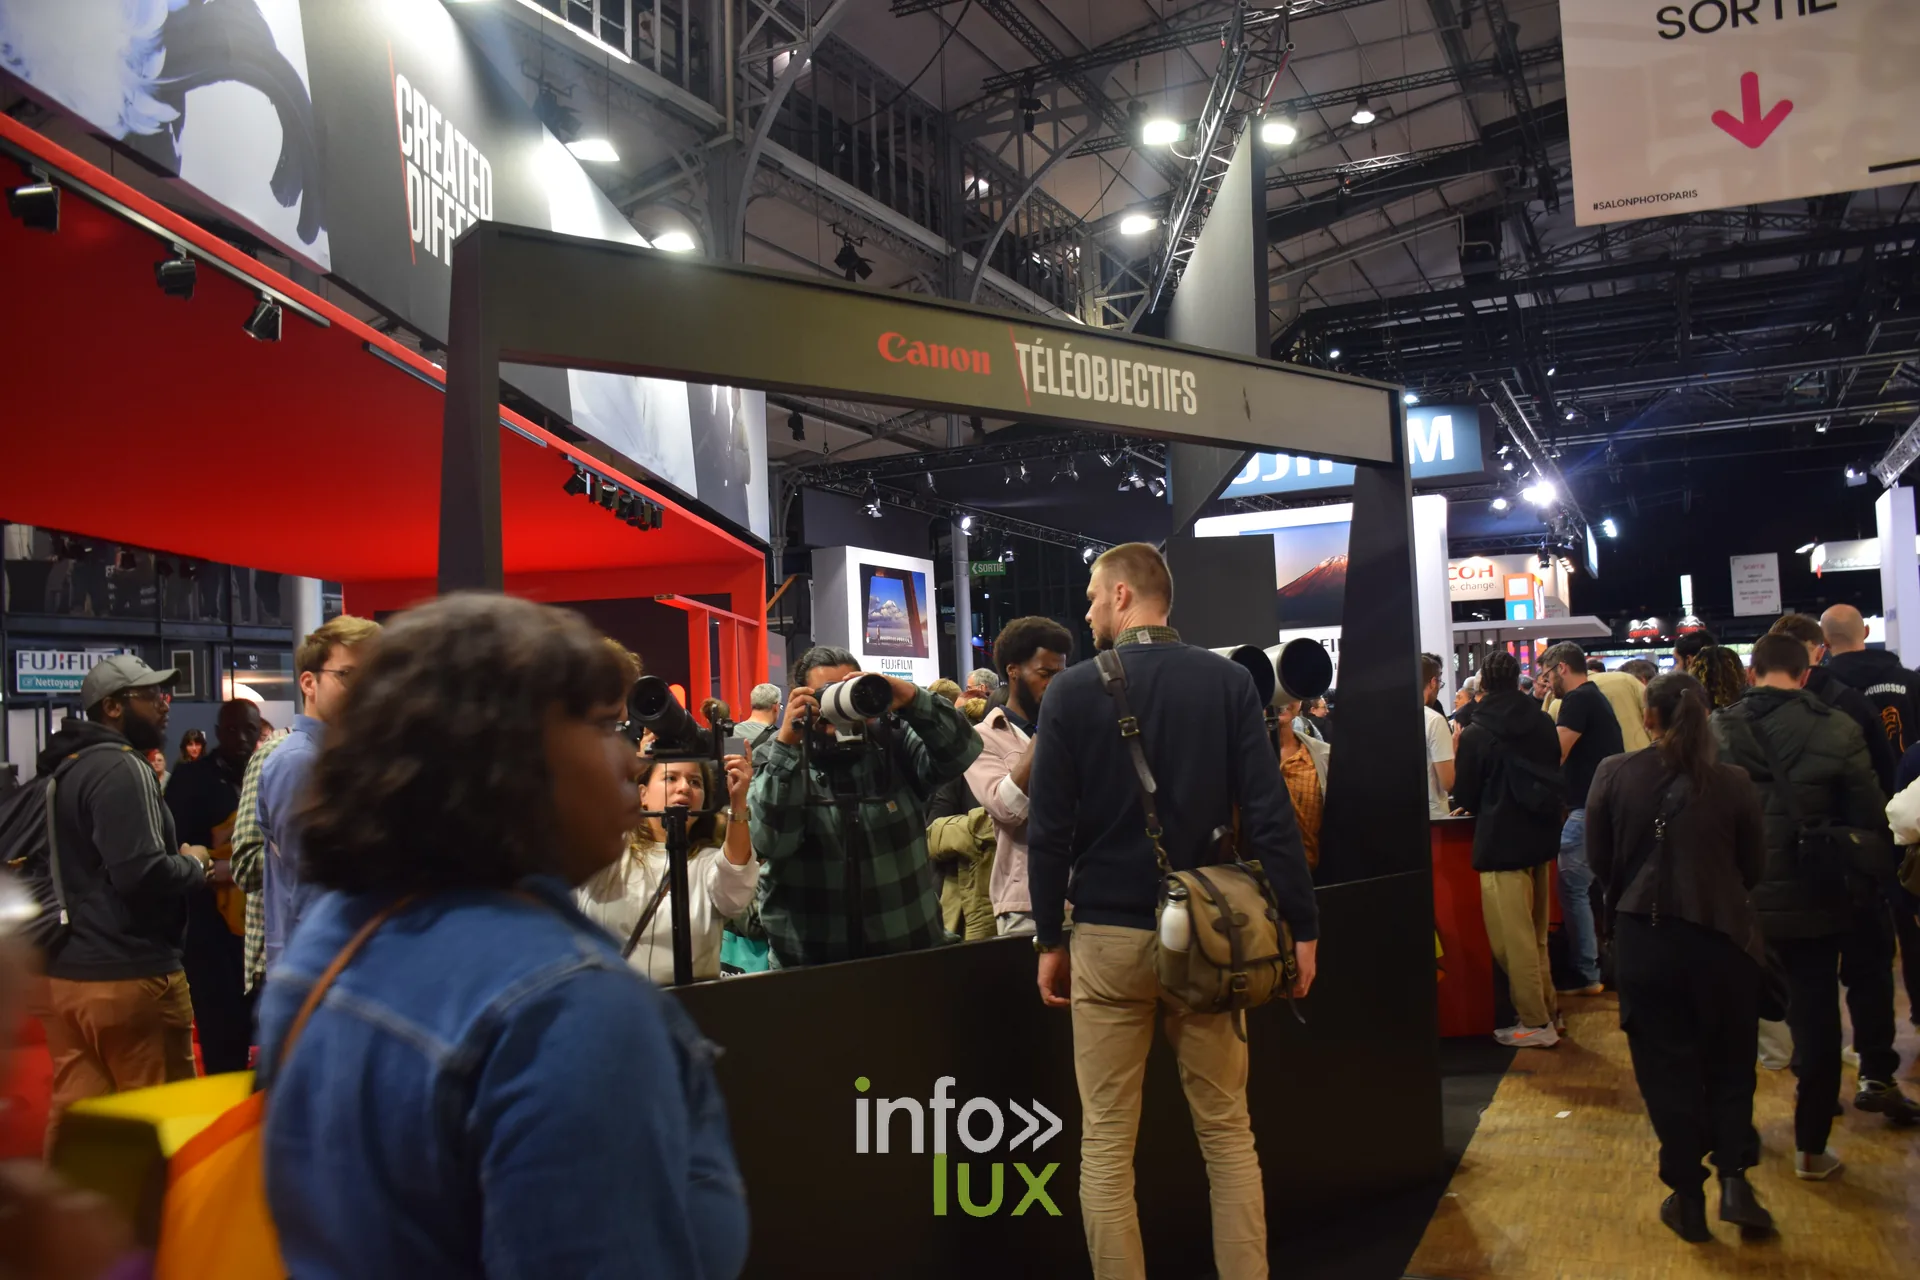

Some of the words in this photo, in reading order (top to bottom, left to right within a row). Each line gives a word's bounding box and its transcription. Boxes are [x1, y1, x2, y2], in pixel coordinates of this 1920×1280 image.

[396, 73, 493, 222] CREATED
[1593, 189, 1698, 211] #SALONPHOTOPARIS
[877, 331, 991, 375] Canon
[1015, 338, 1198, 415] TÉLÉOBJECTIFS
[977, 563, 1004, 573] SORTIE
[1447, 564, 1494, 581] COH
[881, 659, 913, 670] FUJIFILM
[35, 677, 79, 689] Nettoyage
